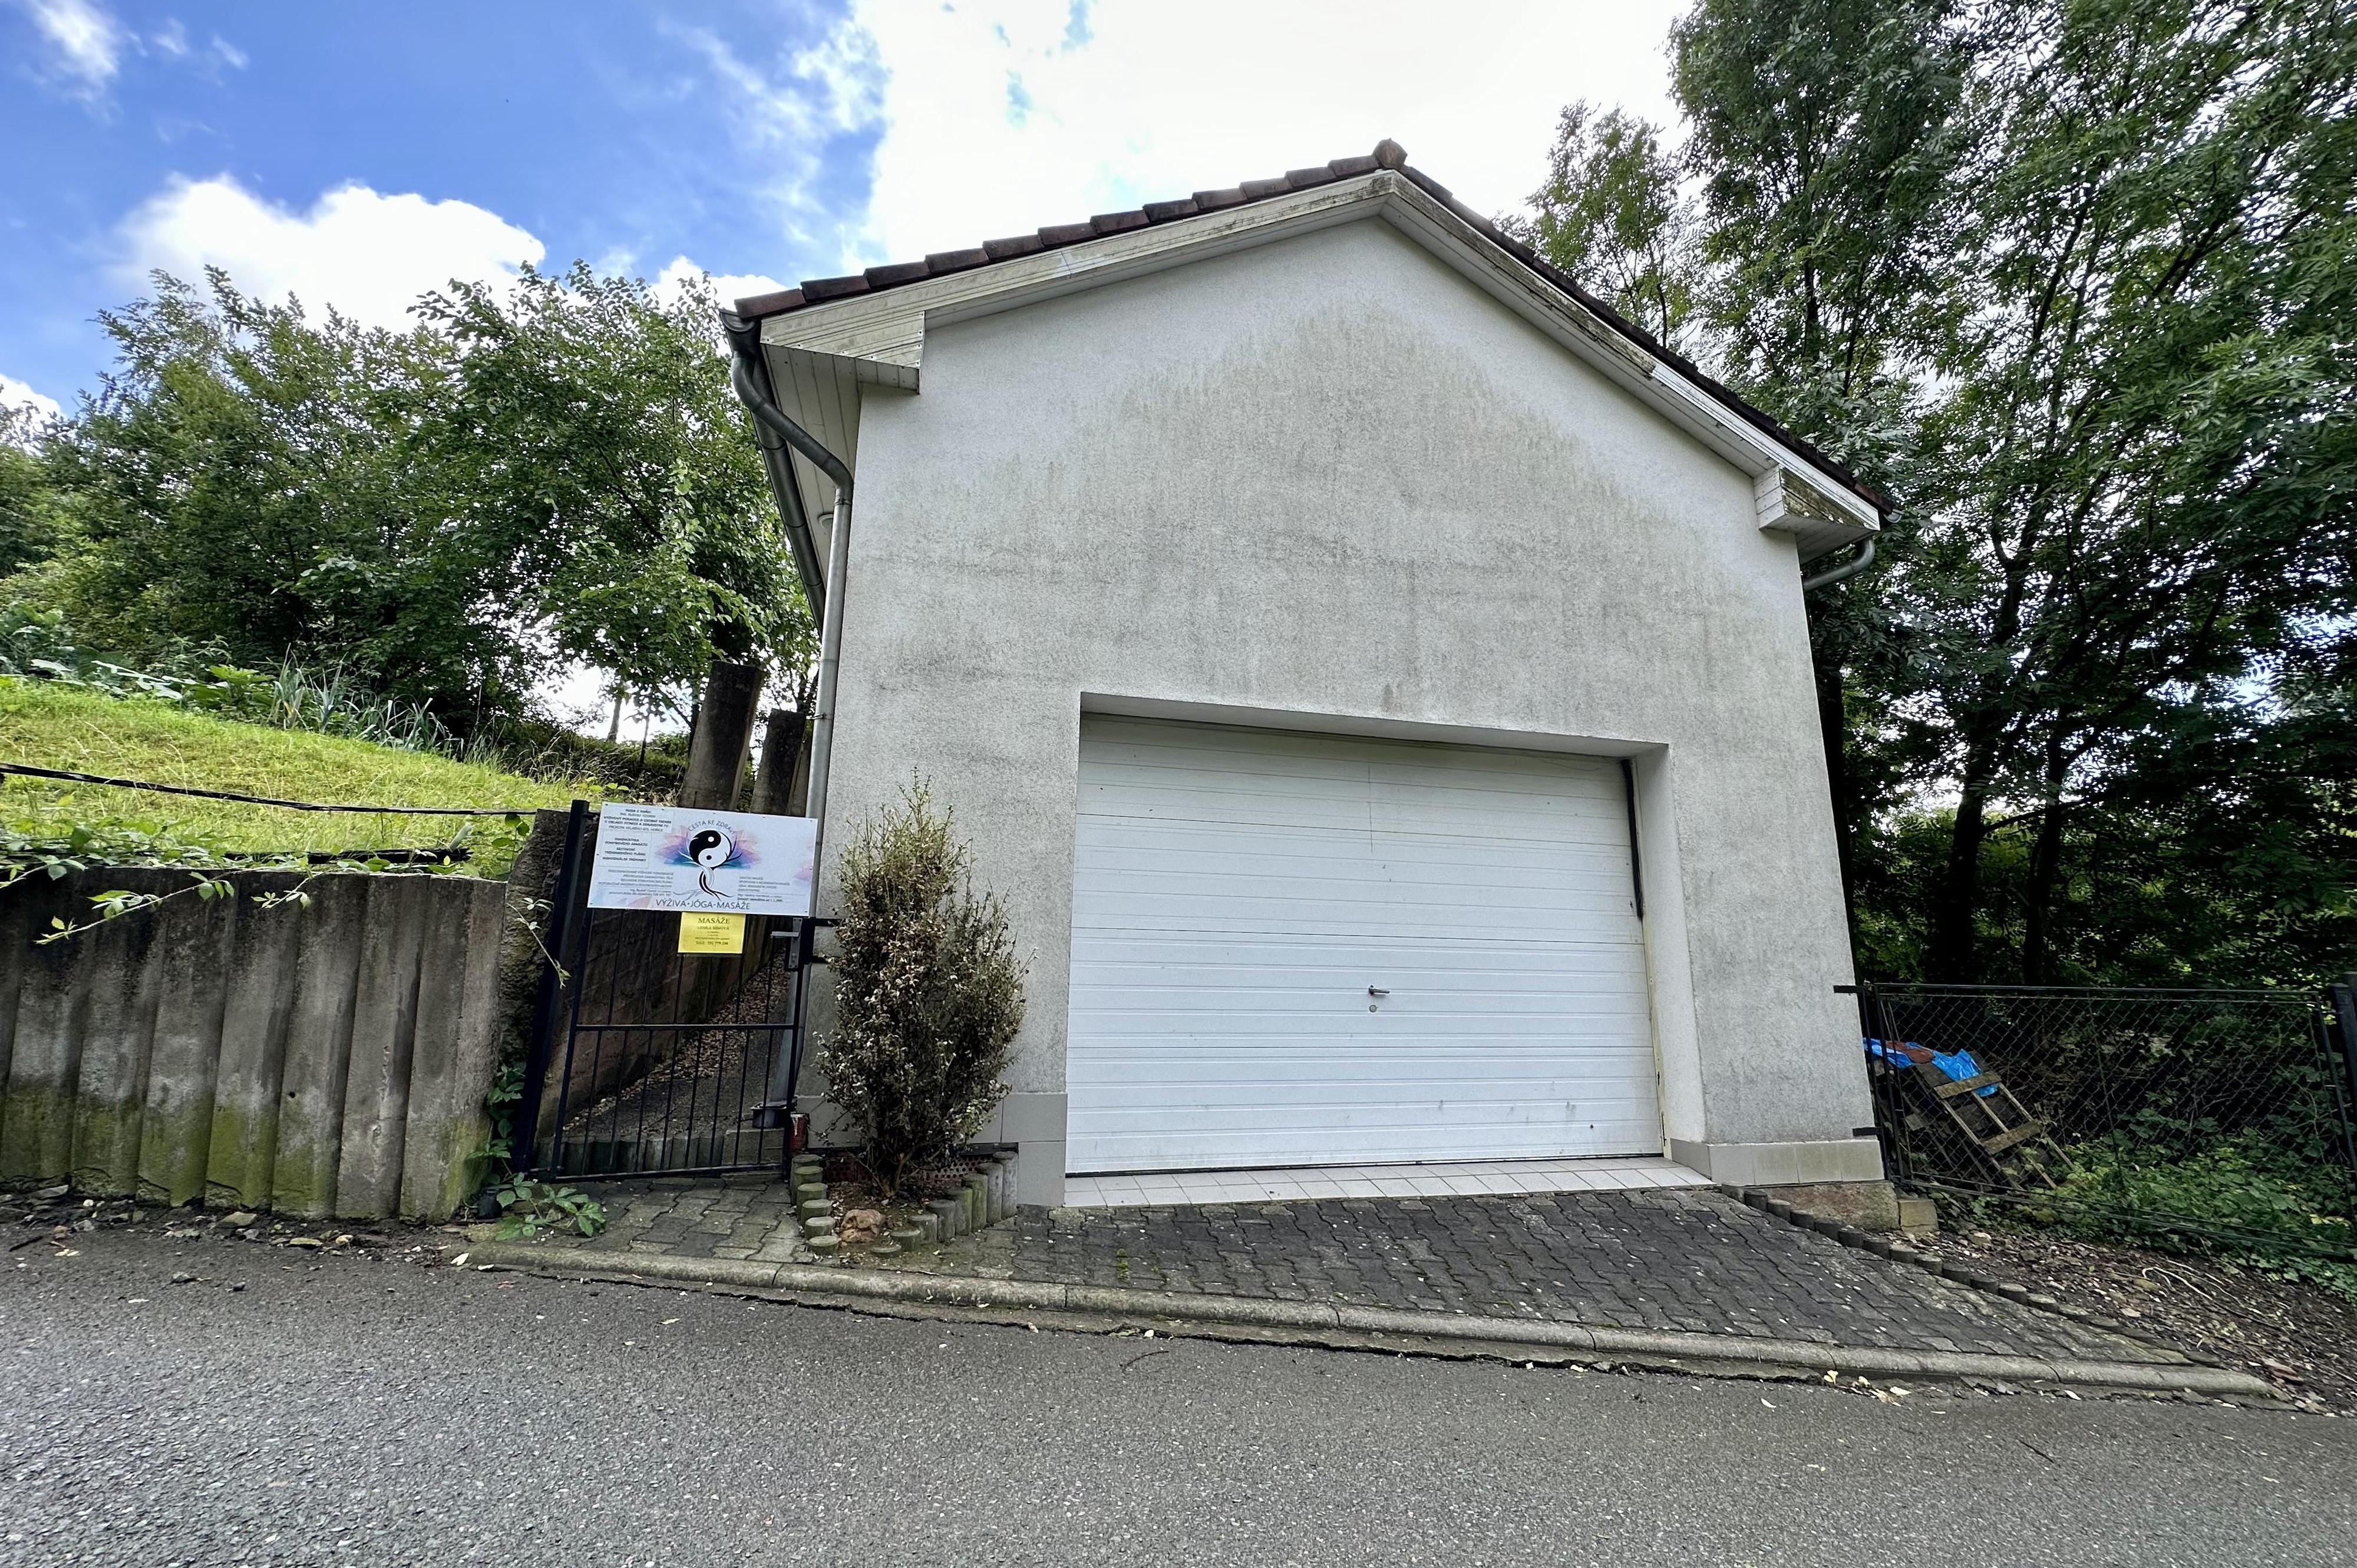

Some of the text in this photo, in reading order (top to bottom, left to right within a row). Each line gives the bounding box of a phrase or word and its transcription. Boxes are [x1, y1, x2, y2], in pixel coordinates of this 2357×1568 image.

[688, 821, 707, 831] CESTA
[655, 898, 686, 907] VÝŽIVA
[689, 899, 713, 908] JÓGA
[717, 900, 750, 910] MASÁŽE
